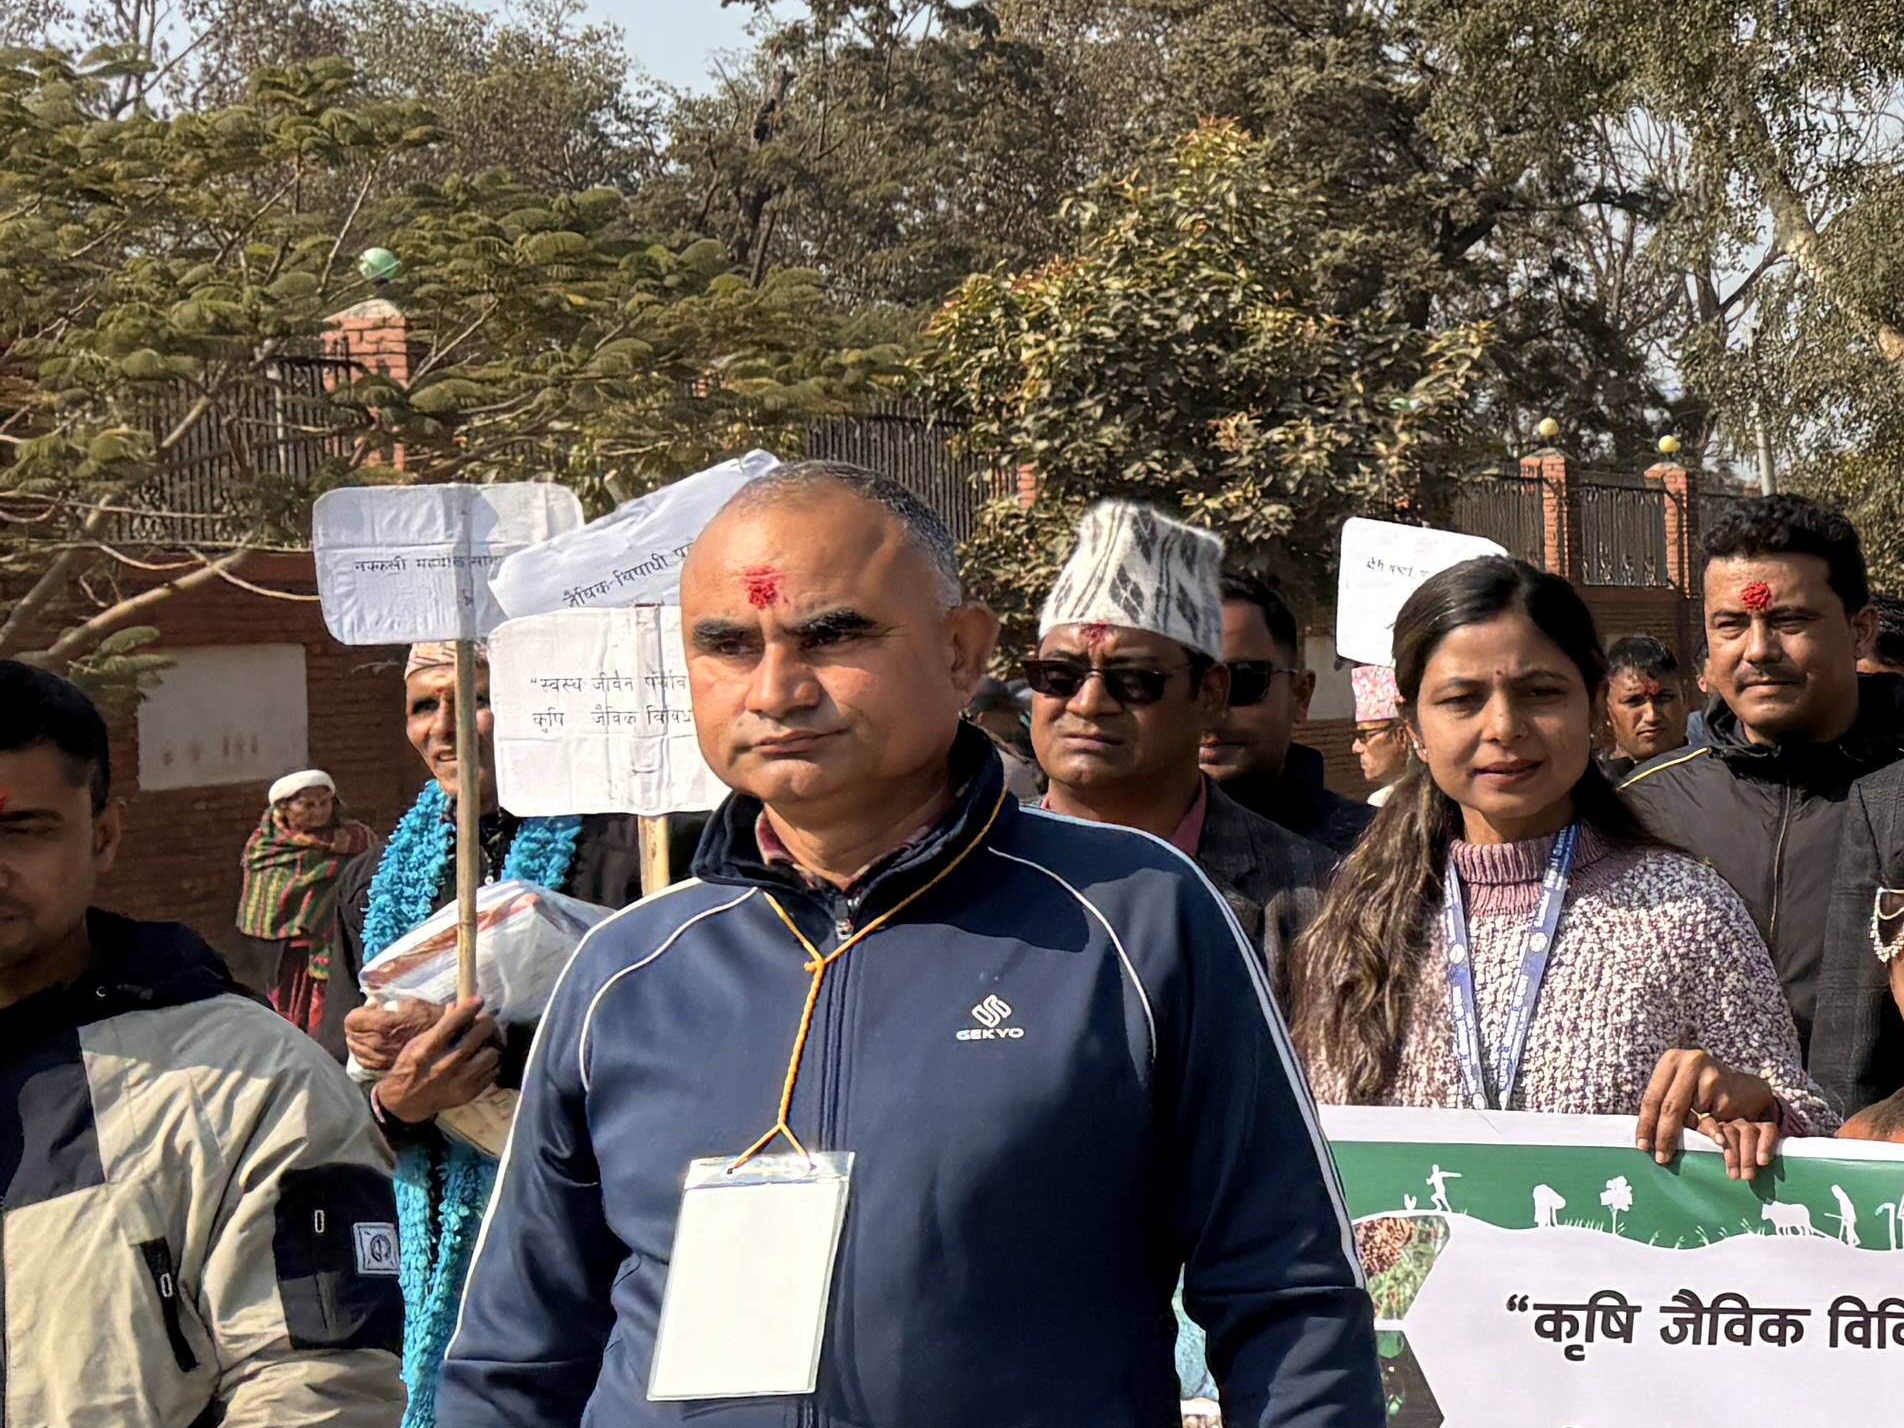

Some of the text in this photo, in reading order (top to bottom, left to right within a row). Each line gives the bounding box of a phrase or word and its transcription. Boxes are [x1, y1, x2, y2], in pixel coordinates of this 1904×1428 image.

[955, 1025, 1025, 1041] GEKYO
[1506, 1289, 1643, 1362] “कृषि
[1659, 1288, 1812, 1348] जैविक
